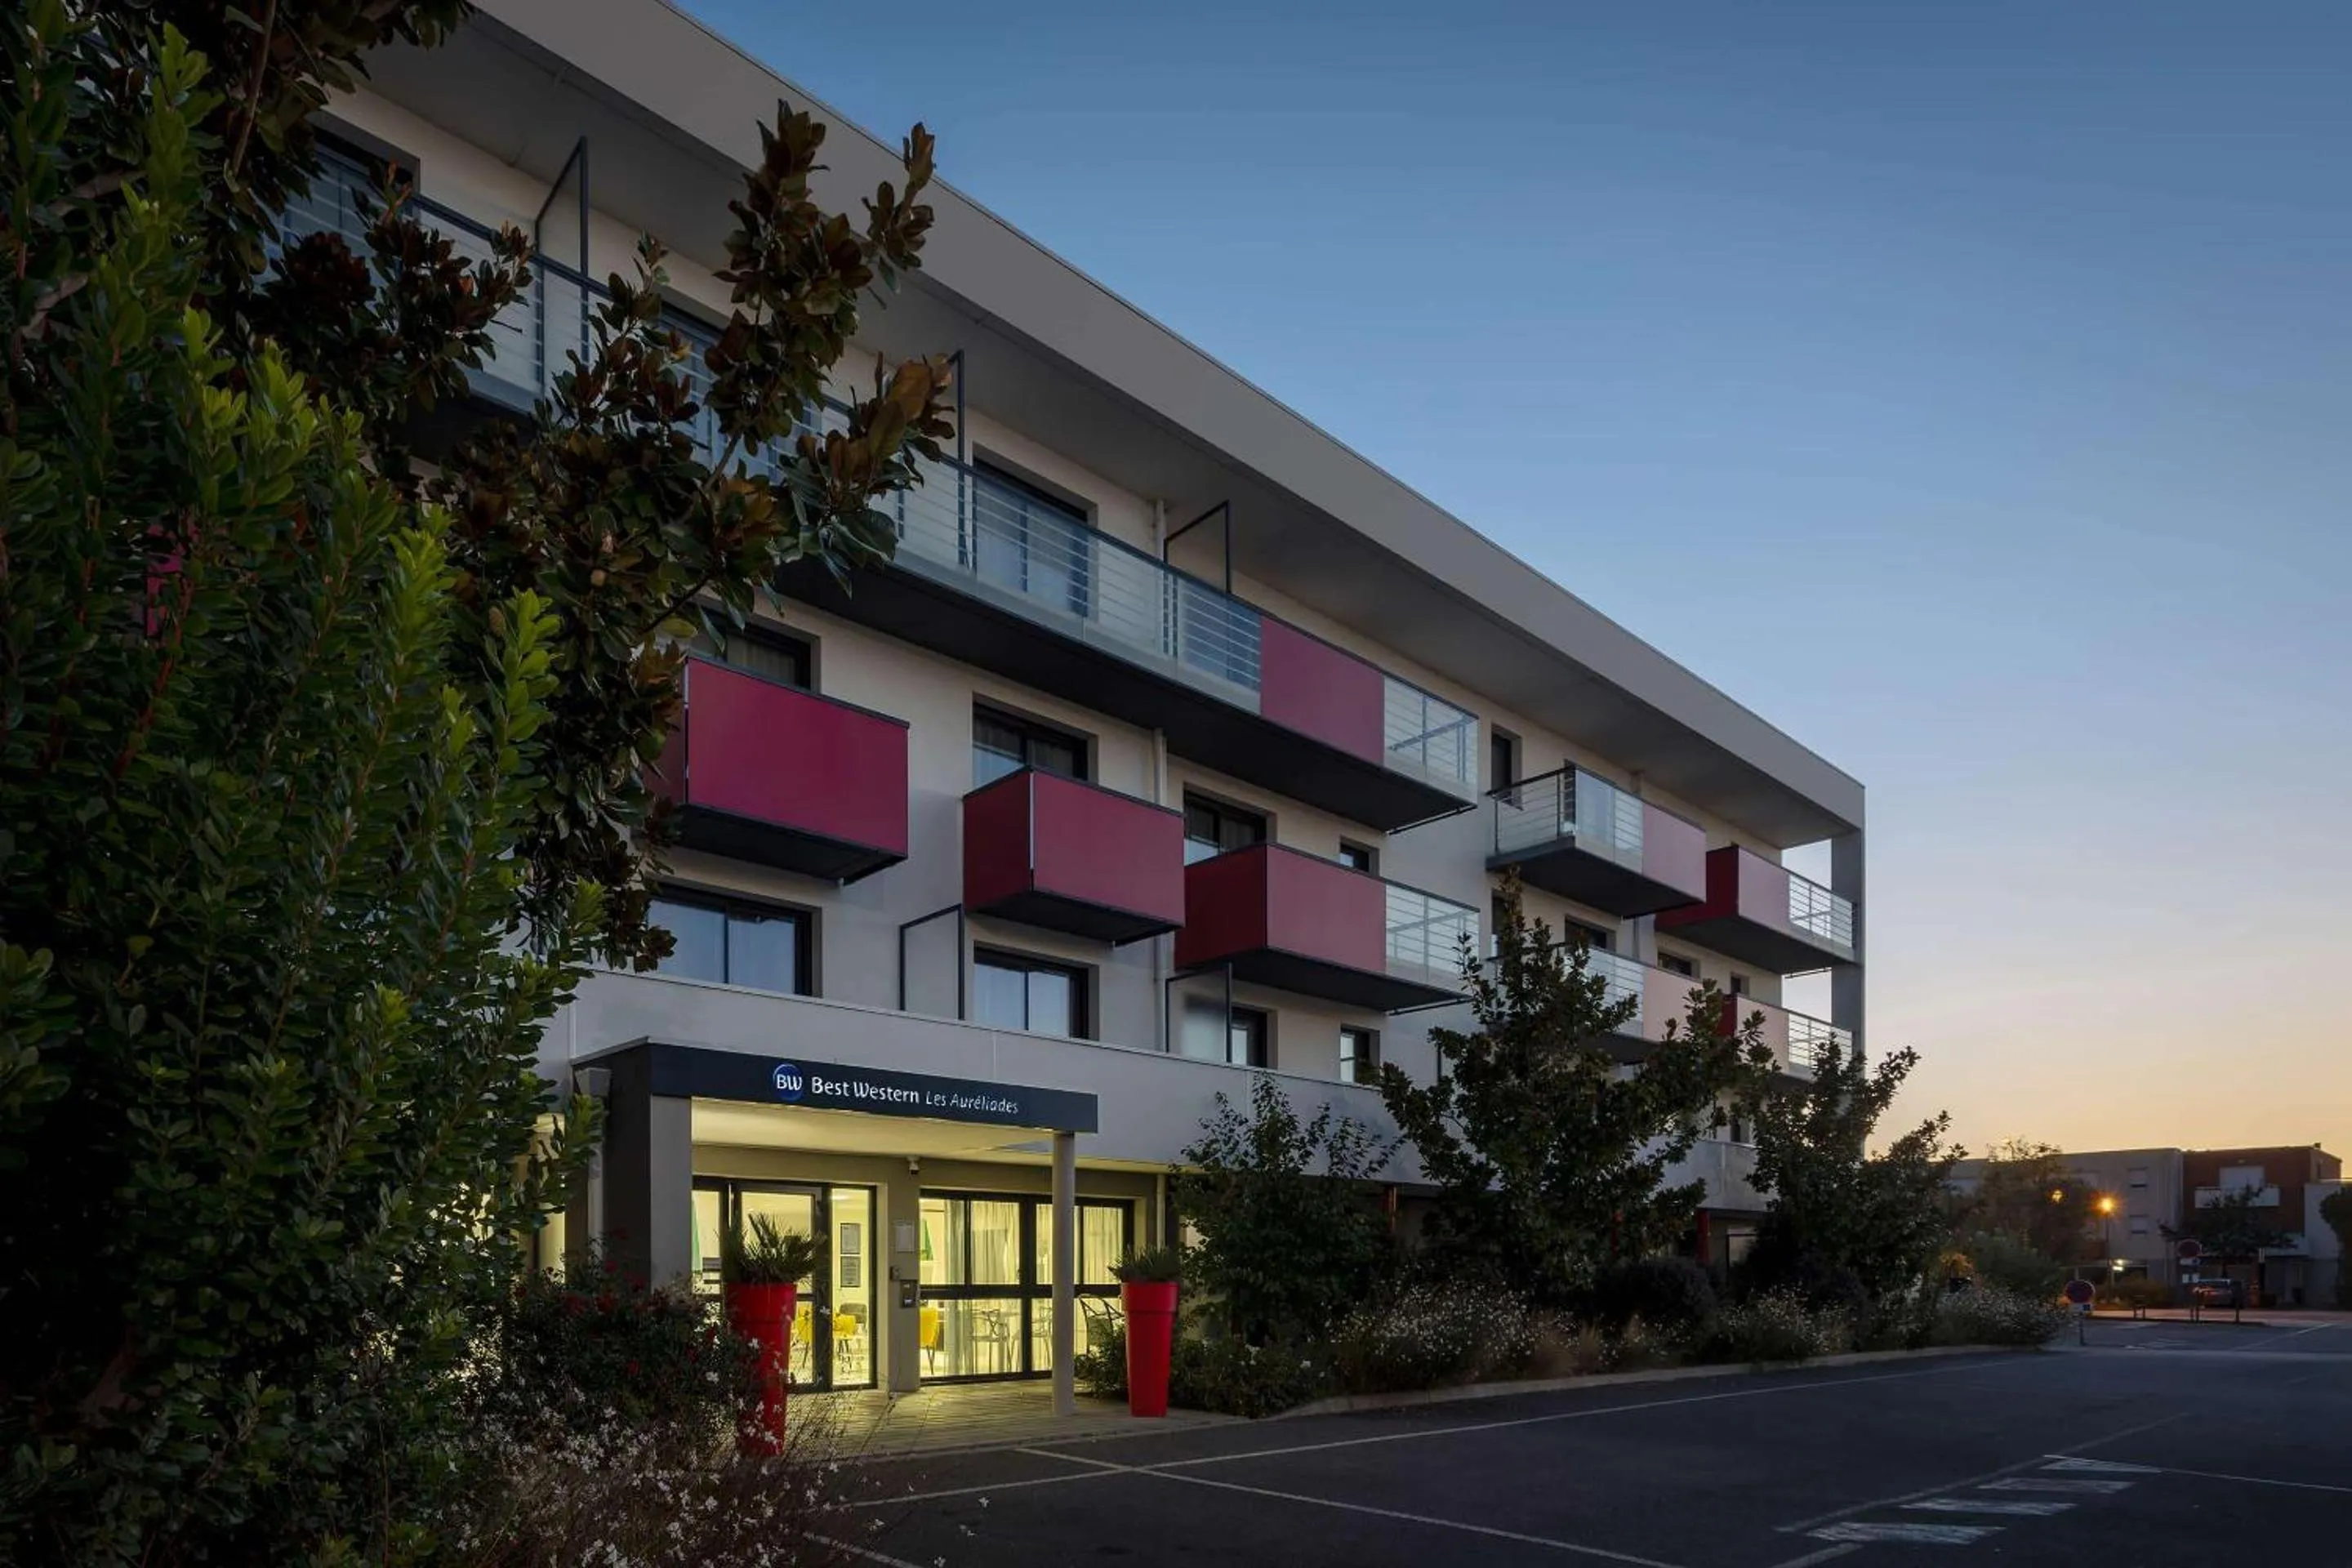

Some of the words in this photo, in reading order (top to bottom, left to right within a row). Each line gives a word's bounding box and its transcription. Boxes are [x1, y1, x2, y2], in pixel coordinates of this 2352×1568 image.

[777, 1074, 802, 1090] BW
[812, 1076, 849, 1097] Best
[853, 1081, 919, 1103] Western
[926, 1091, 946, 1106] Les
[950, 1094, 1018, 1114] Auréliades
